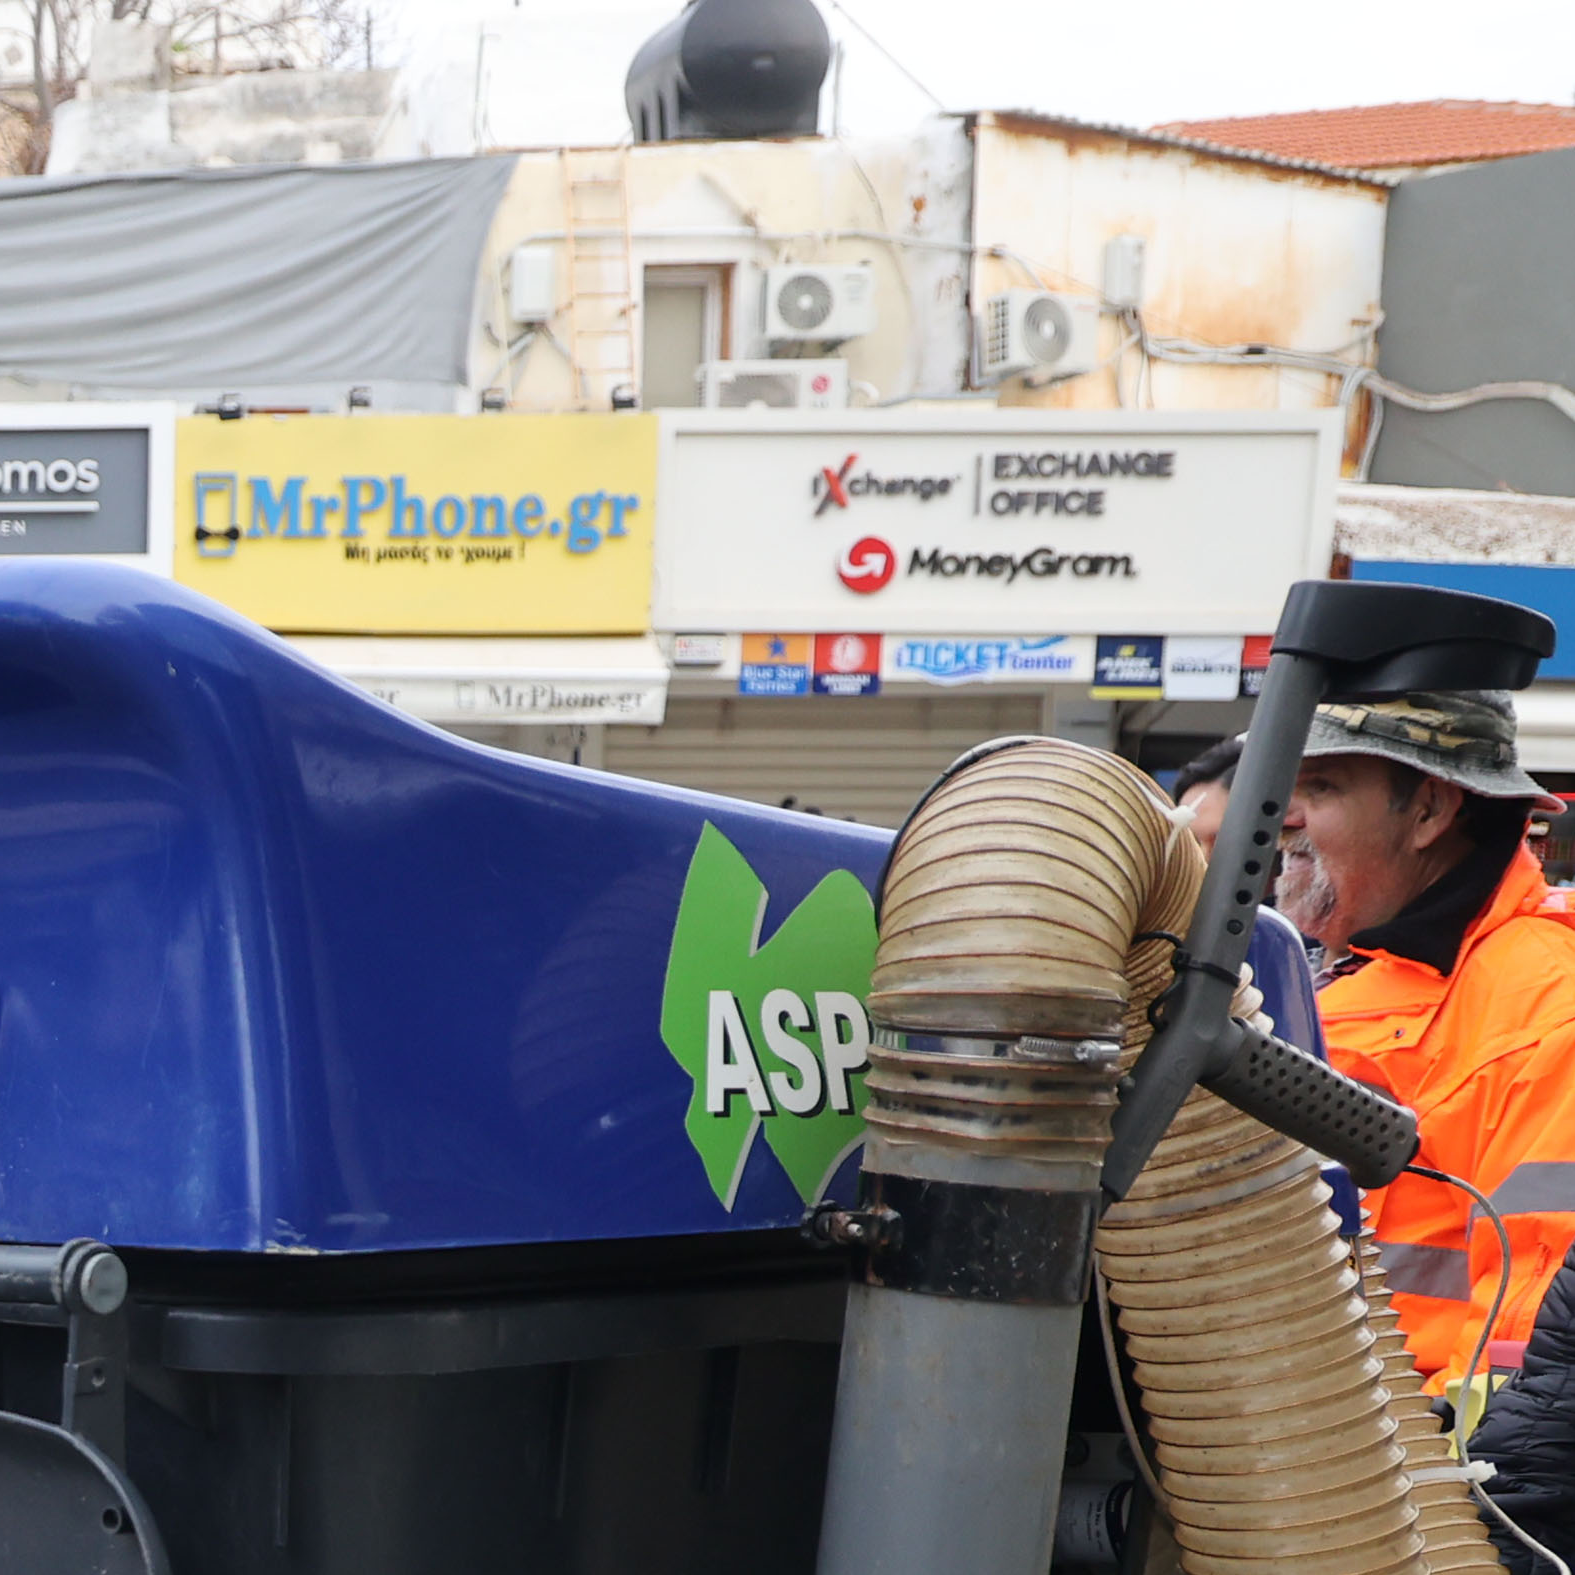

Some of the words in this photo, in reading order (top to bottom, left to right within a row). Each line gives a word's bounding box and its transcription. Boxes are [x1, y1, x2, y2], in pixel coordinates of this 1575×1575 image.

[993, 452, 1175, 480] EXCHANGE
[248, 473, 639, 553] MrPhone.gr
[991, 489, 1107, 517] OFFICE
[487, 684, 647, 713] MrPhone.gr
